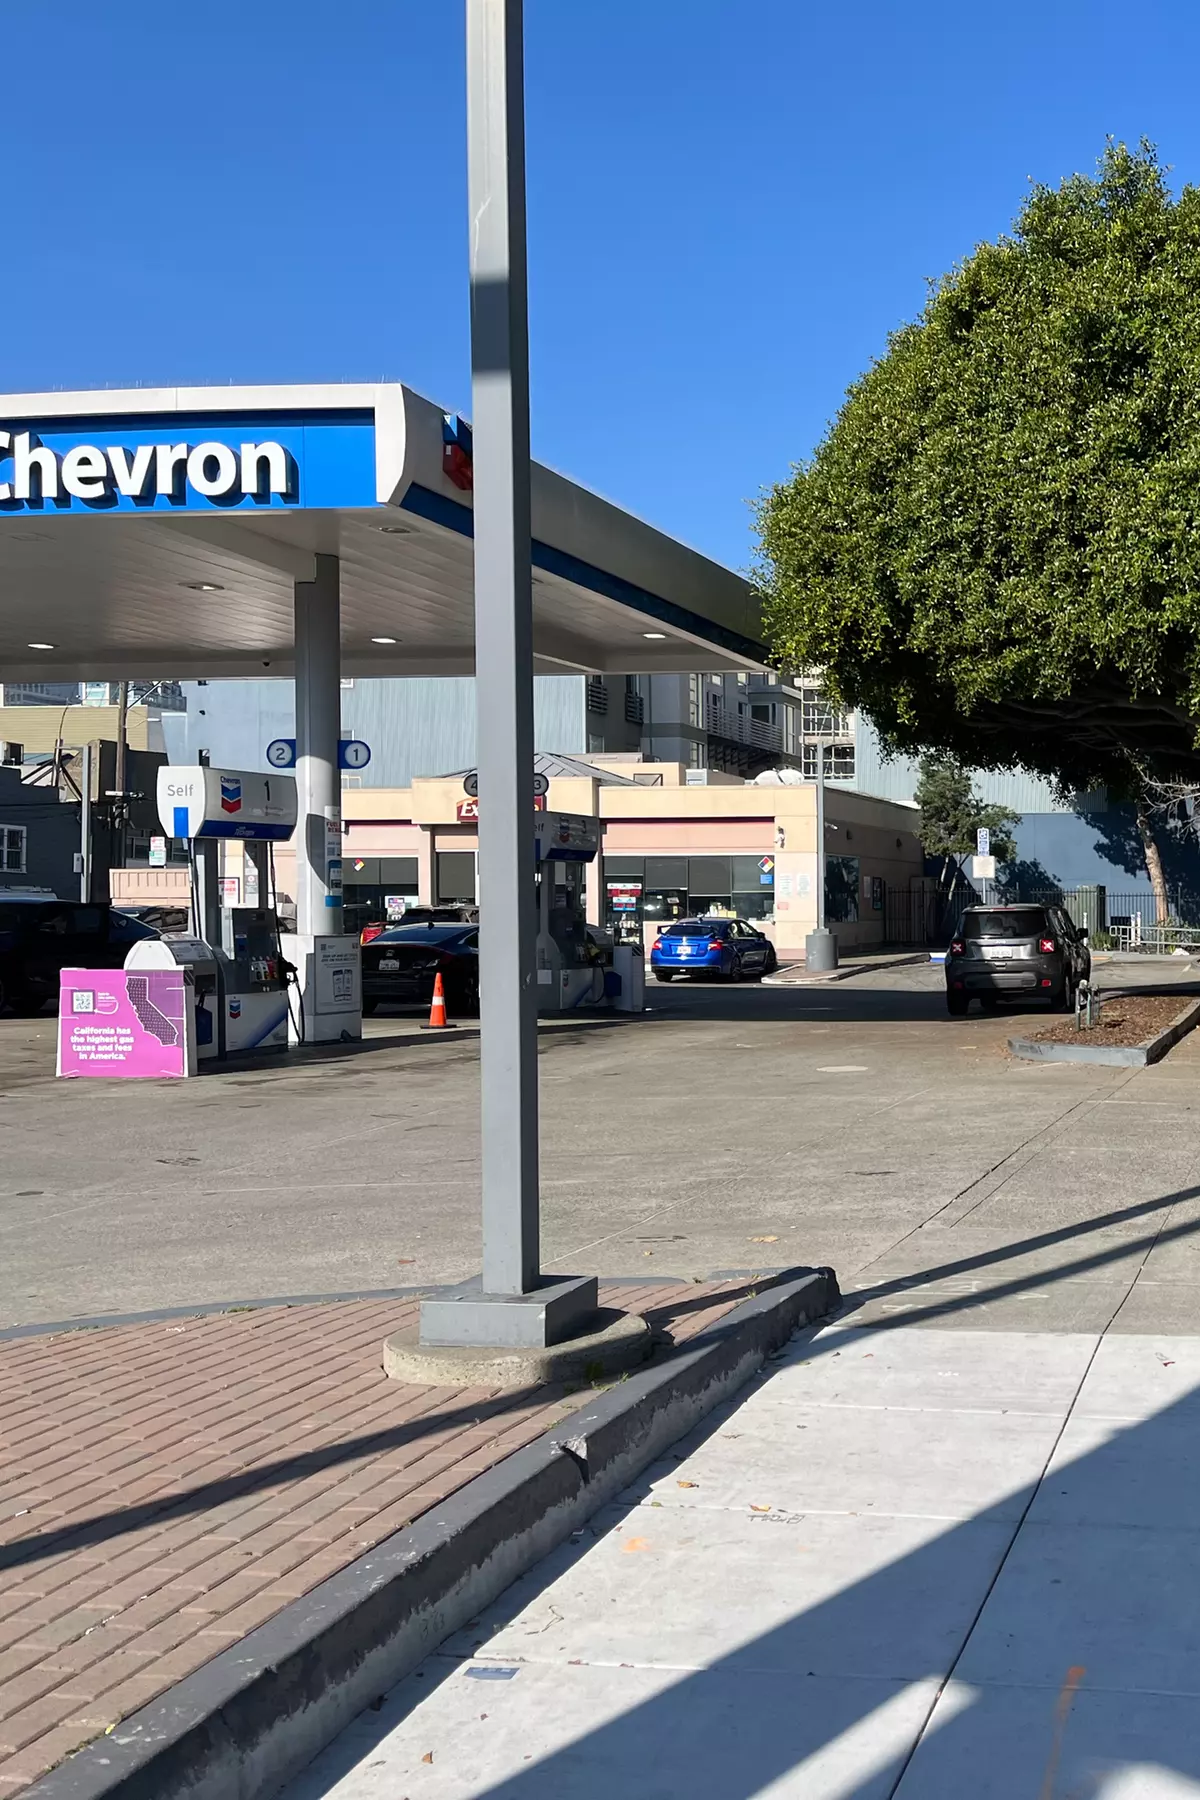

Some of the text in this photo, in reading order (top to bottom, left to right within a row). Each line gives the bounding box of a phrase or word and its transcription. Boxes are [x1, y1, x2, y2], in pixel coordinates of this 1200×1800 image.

[0, 431, 287, 500] hevron
[275, 747, 286, 761] 2
[352, 748, 359, 762] 1
[471, 780, 479, 790] 4
[534, 780, 541, 790] 3
[167, 784, 194, 797] Self
[264, 780, 271, 801] 1
[73, 1026, 131, 1035] California has
[70, 1035, 134, 1045] the highest gas
[72, 1044, 132, 1052] taxes and fees
[79, 1052, 126, 1060] in America.
